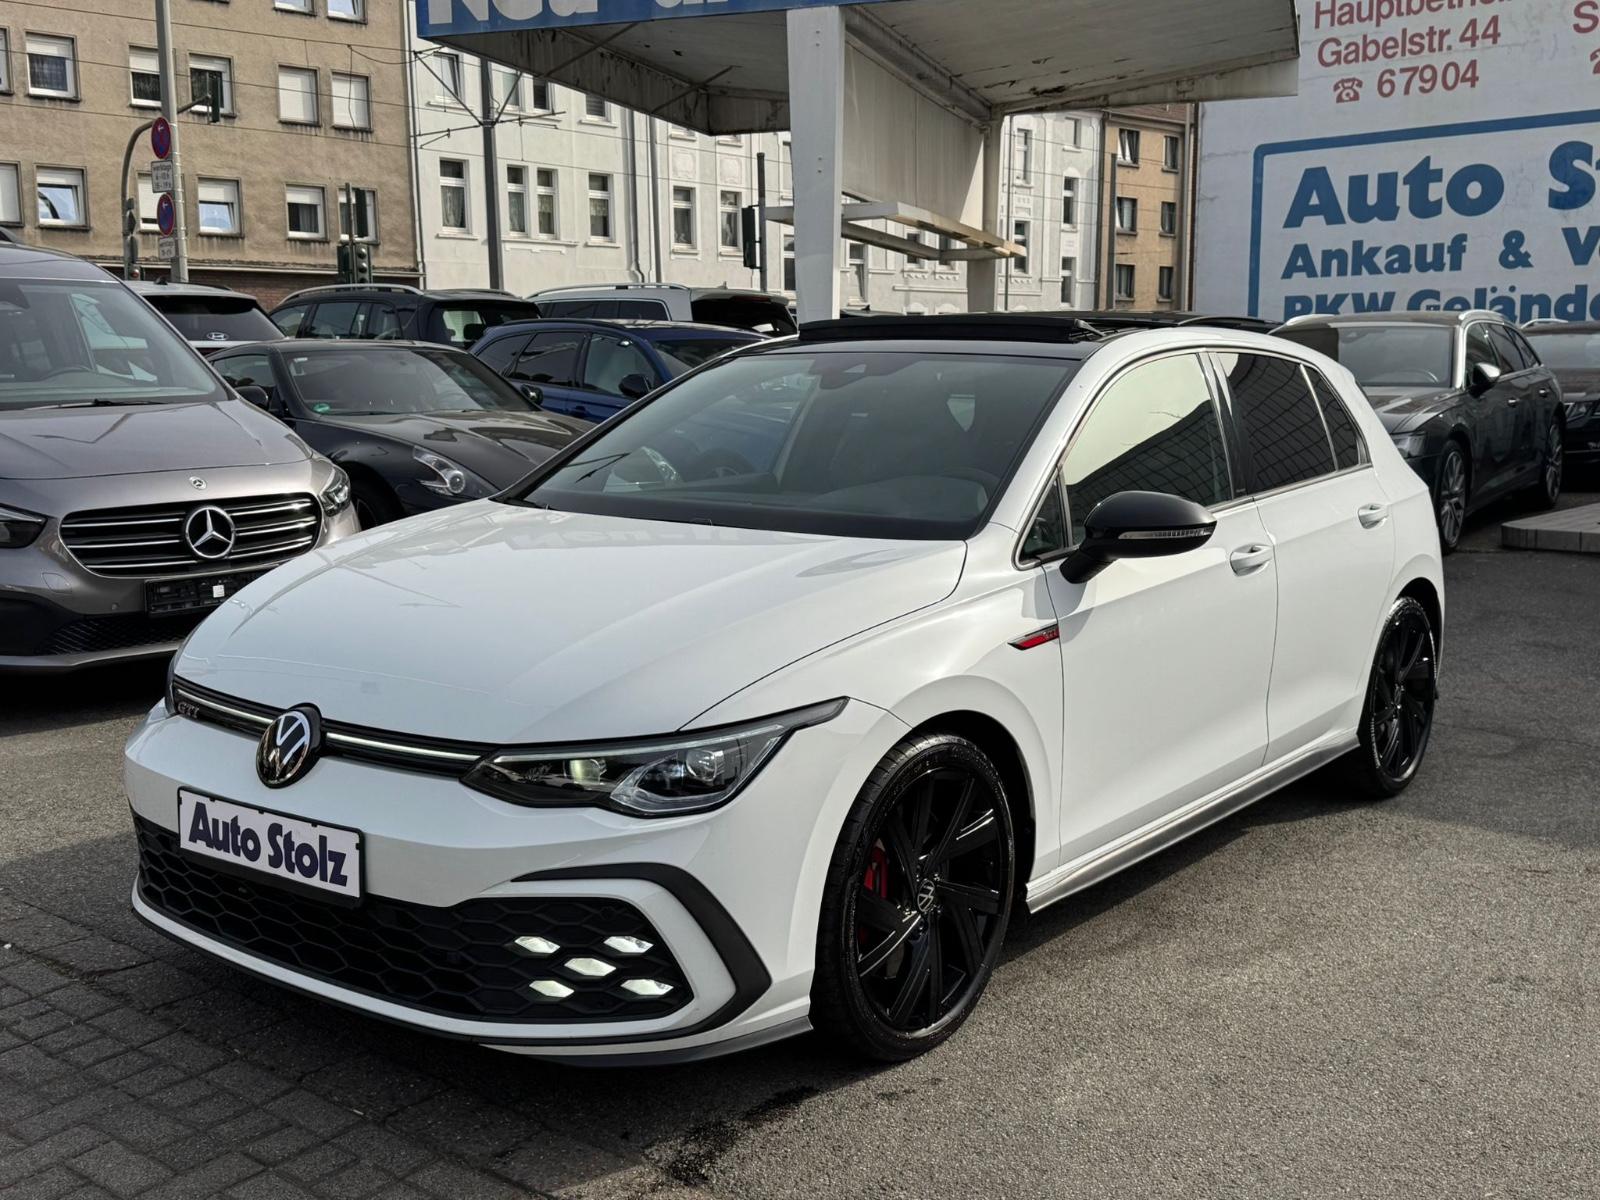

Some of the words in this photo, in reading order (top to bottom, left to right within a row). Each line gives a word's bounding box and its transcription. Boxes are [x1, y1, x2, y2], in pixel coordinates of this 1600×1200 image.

[1318, 26, 1453, 68] Gabelstr.
[1459, 15, 1501, 48] 44
[1376, 59, 1479, 98] 67904
[1282, 155, 1505, 229] Auto
[1548, 140, 1600, 211] S
[1280, 233, 1469, 280] Ankauf
[1498, 230, 1534, 270] &
[1561, 225, 1600, 266] V
[1283, 291, 1396, 322] PKW
[177, 701, 200, 719] GTI
[188, 801, 261, 862] Auto
[267, 822, 348, 887] Stolz
